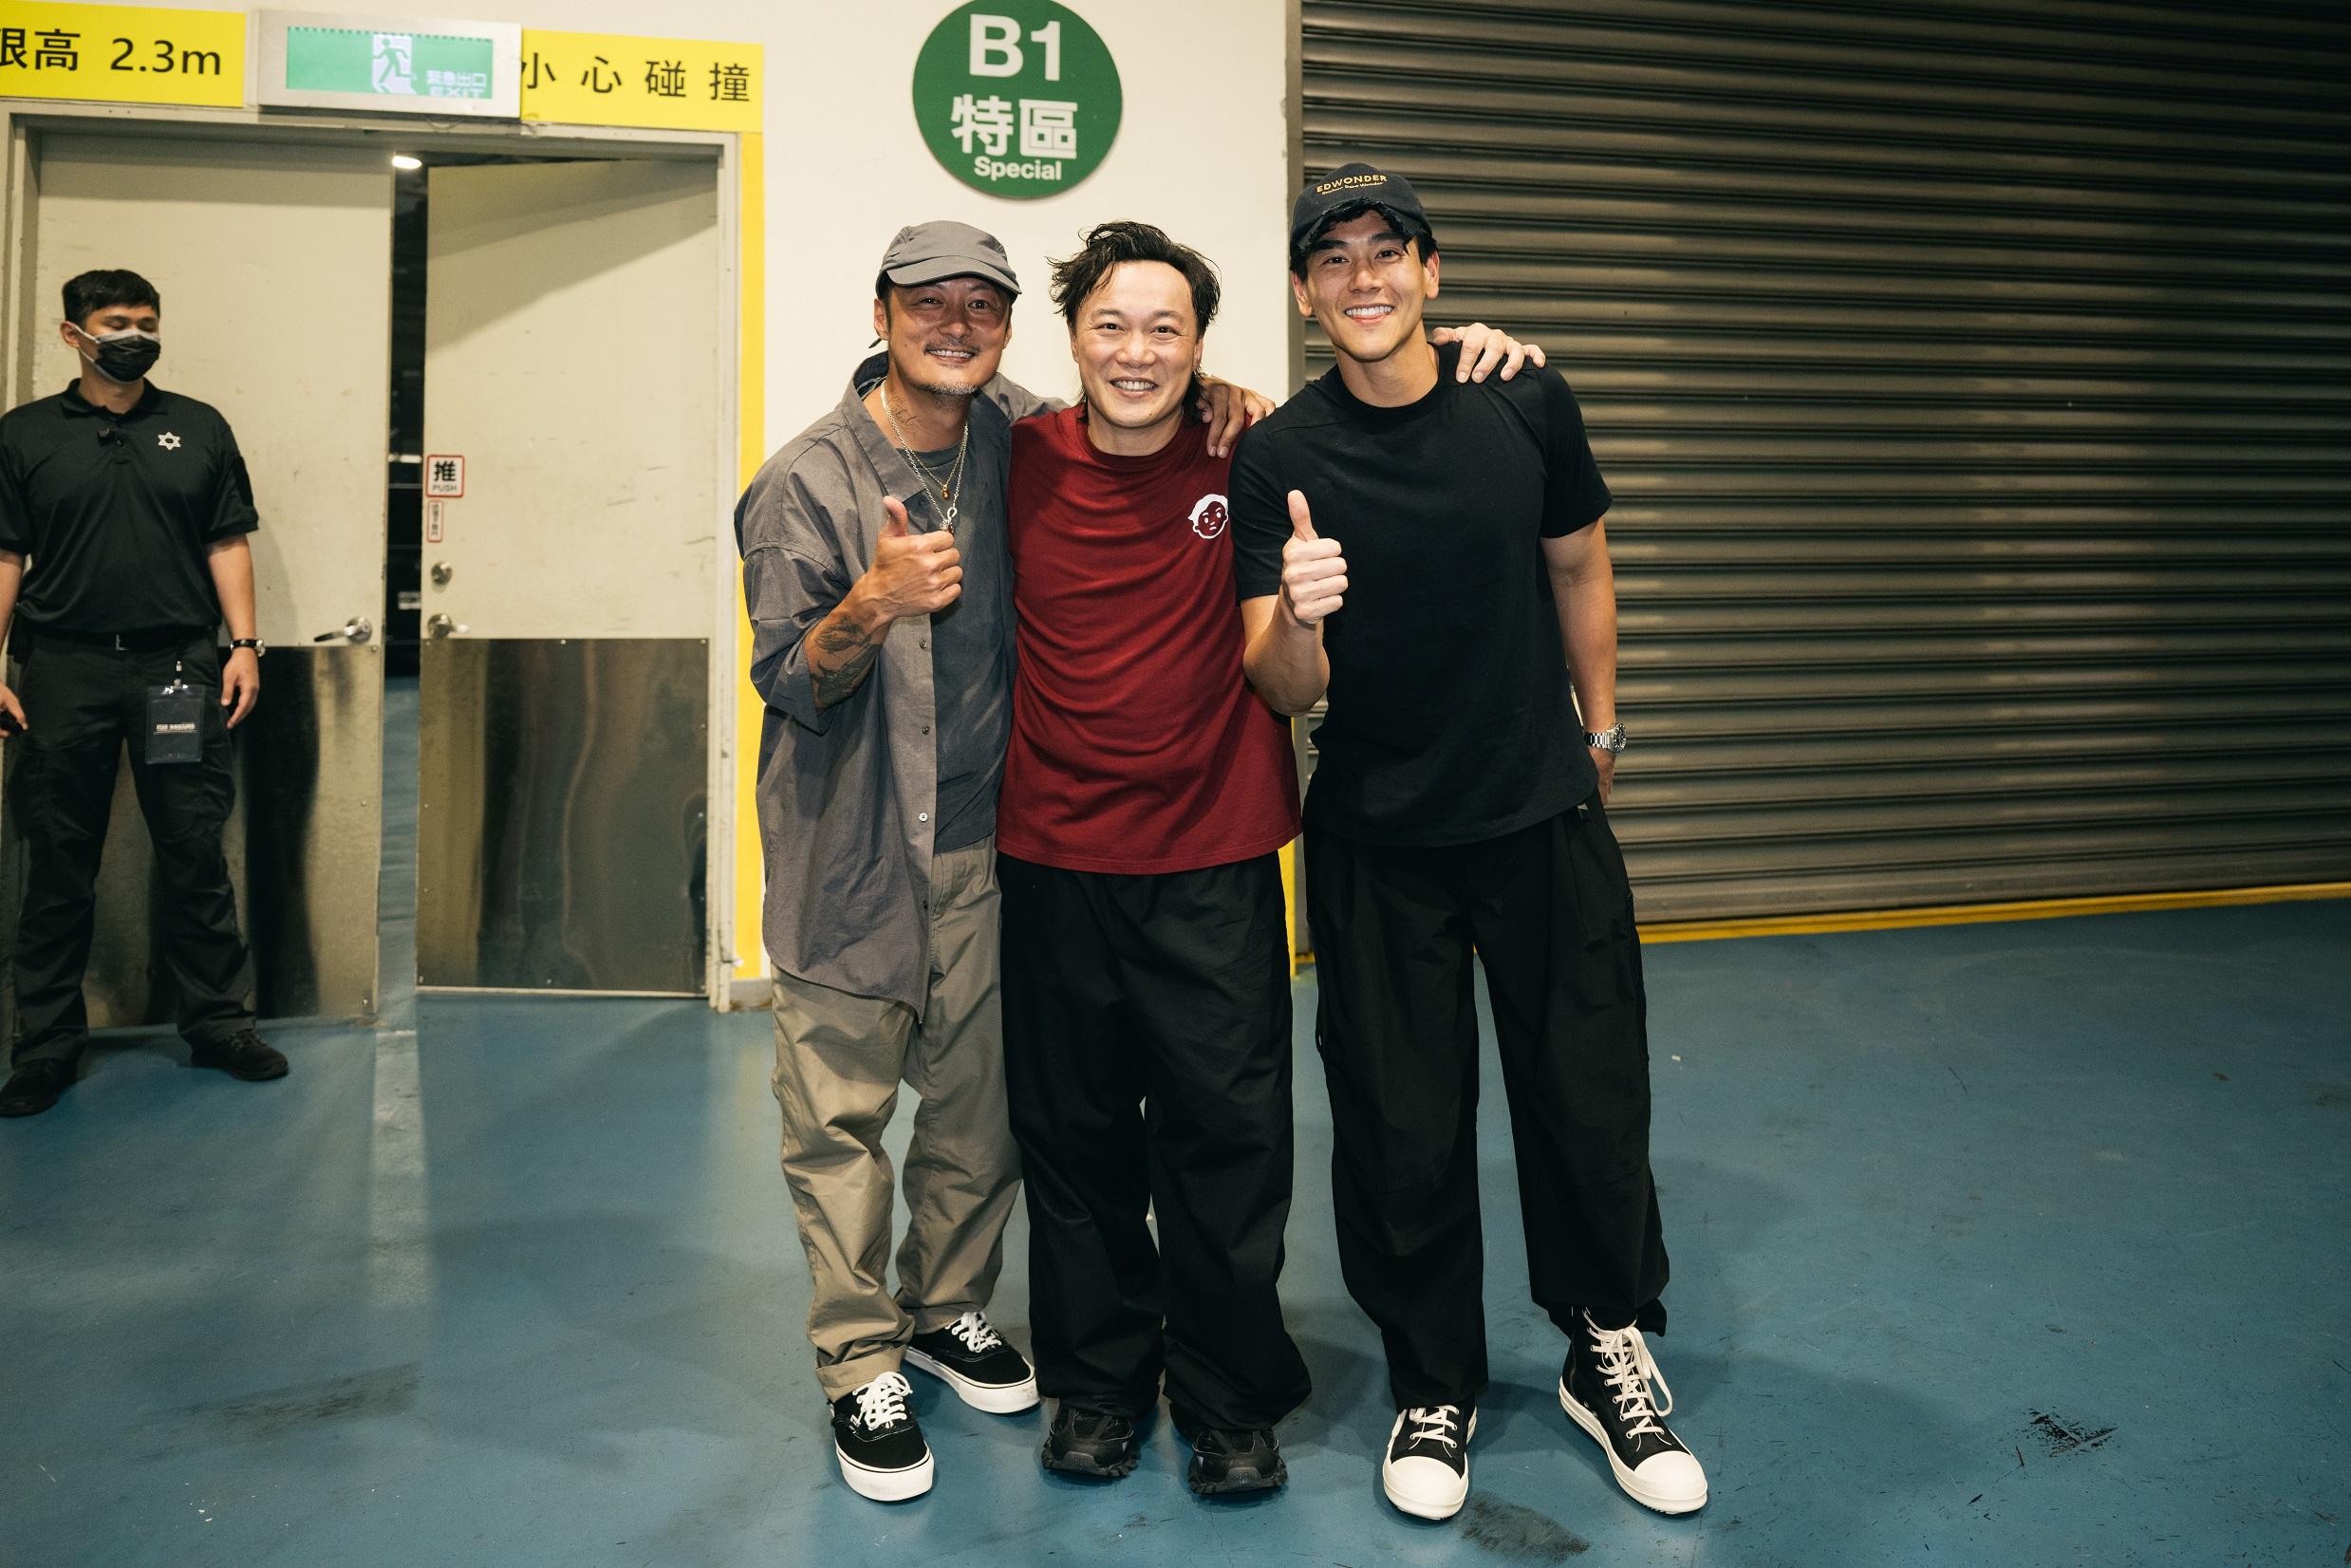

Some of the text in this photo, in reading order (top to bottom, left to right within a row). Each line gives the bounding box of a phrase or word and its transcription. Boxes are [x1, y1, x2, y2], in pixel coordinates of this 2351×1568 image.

[110, 37, 222, 76] 2.3m
[969, 13, 1061, 82] B1
[521, 52, 750, 102] 小心碰撞
[950, 93, 1078, 159] 特區
[974, 156, 1062, 181] Special
[1316, 175, 1387, 193] EDWONDER
[434, 460, 456, 481] 推
